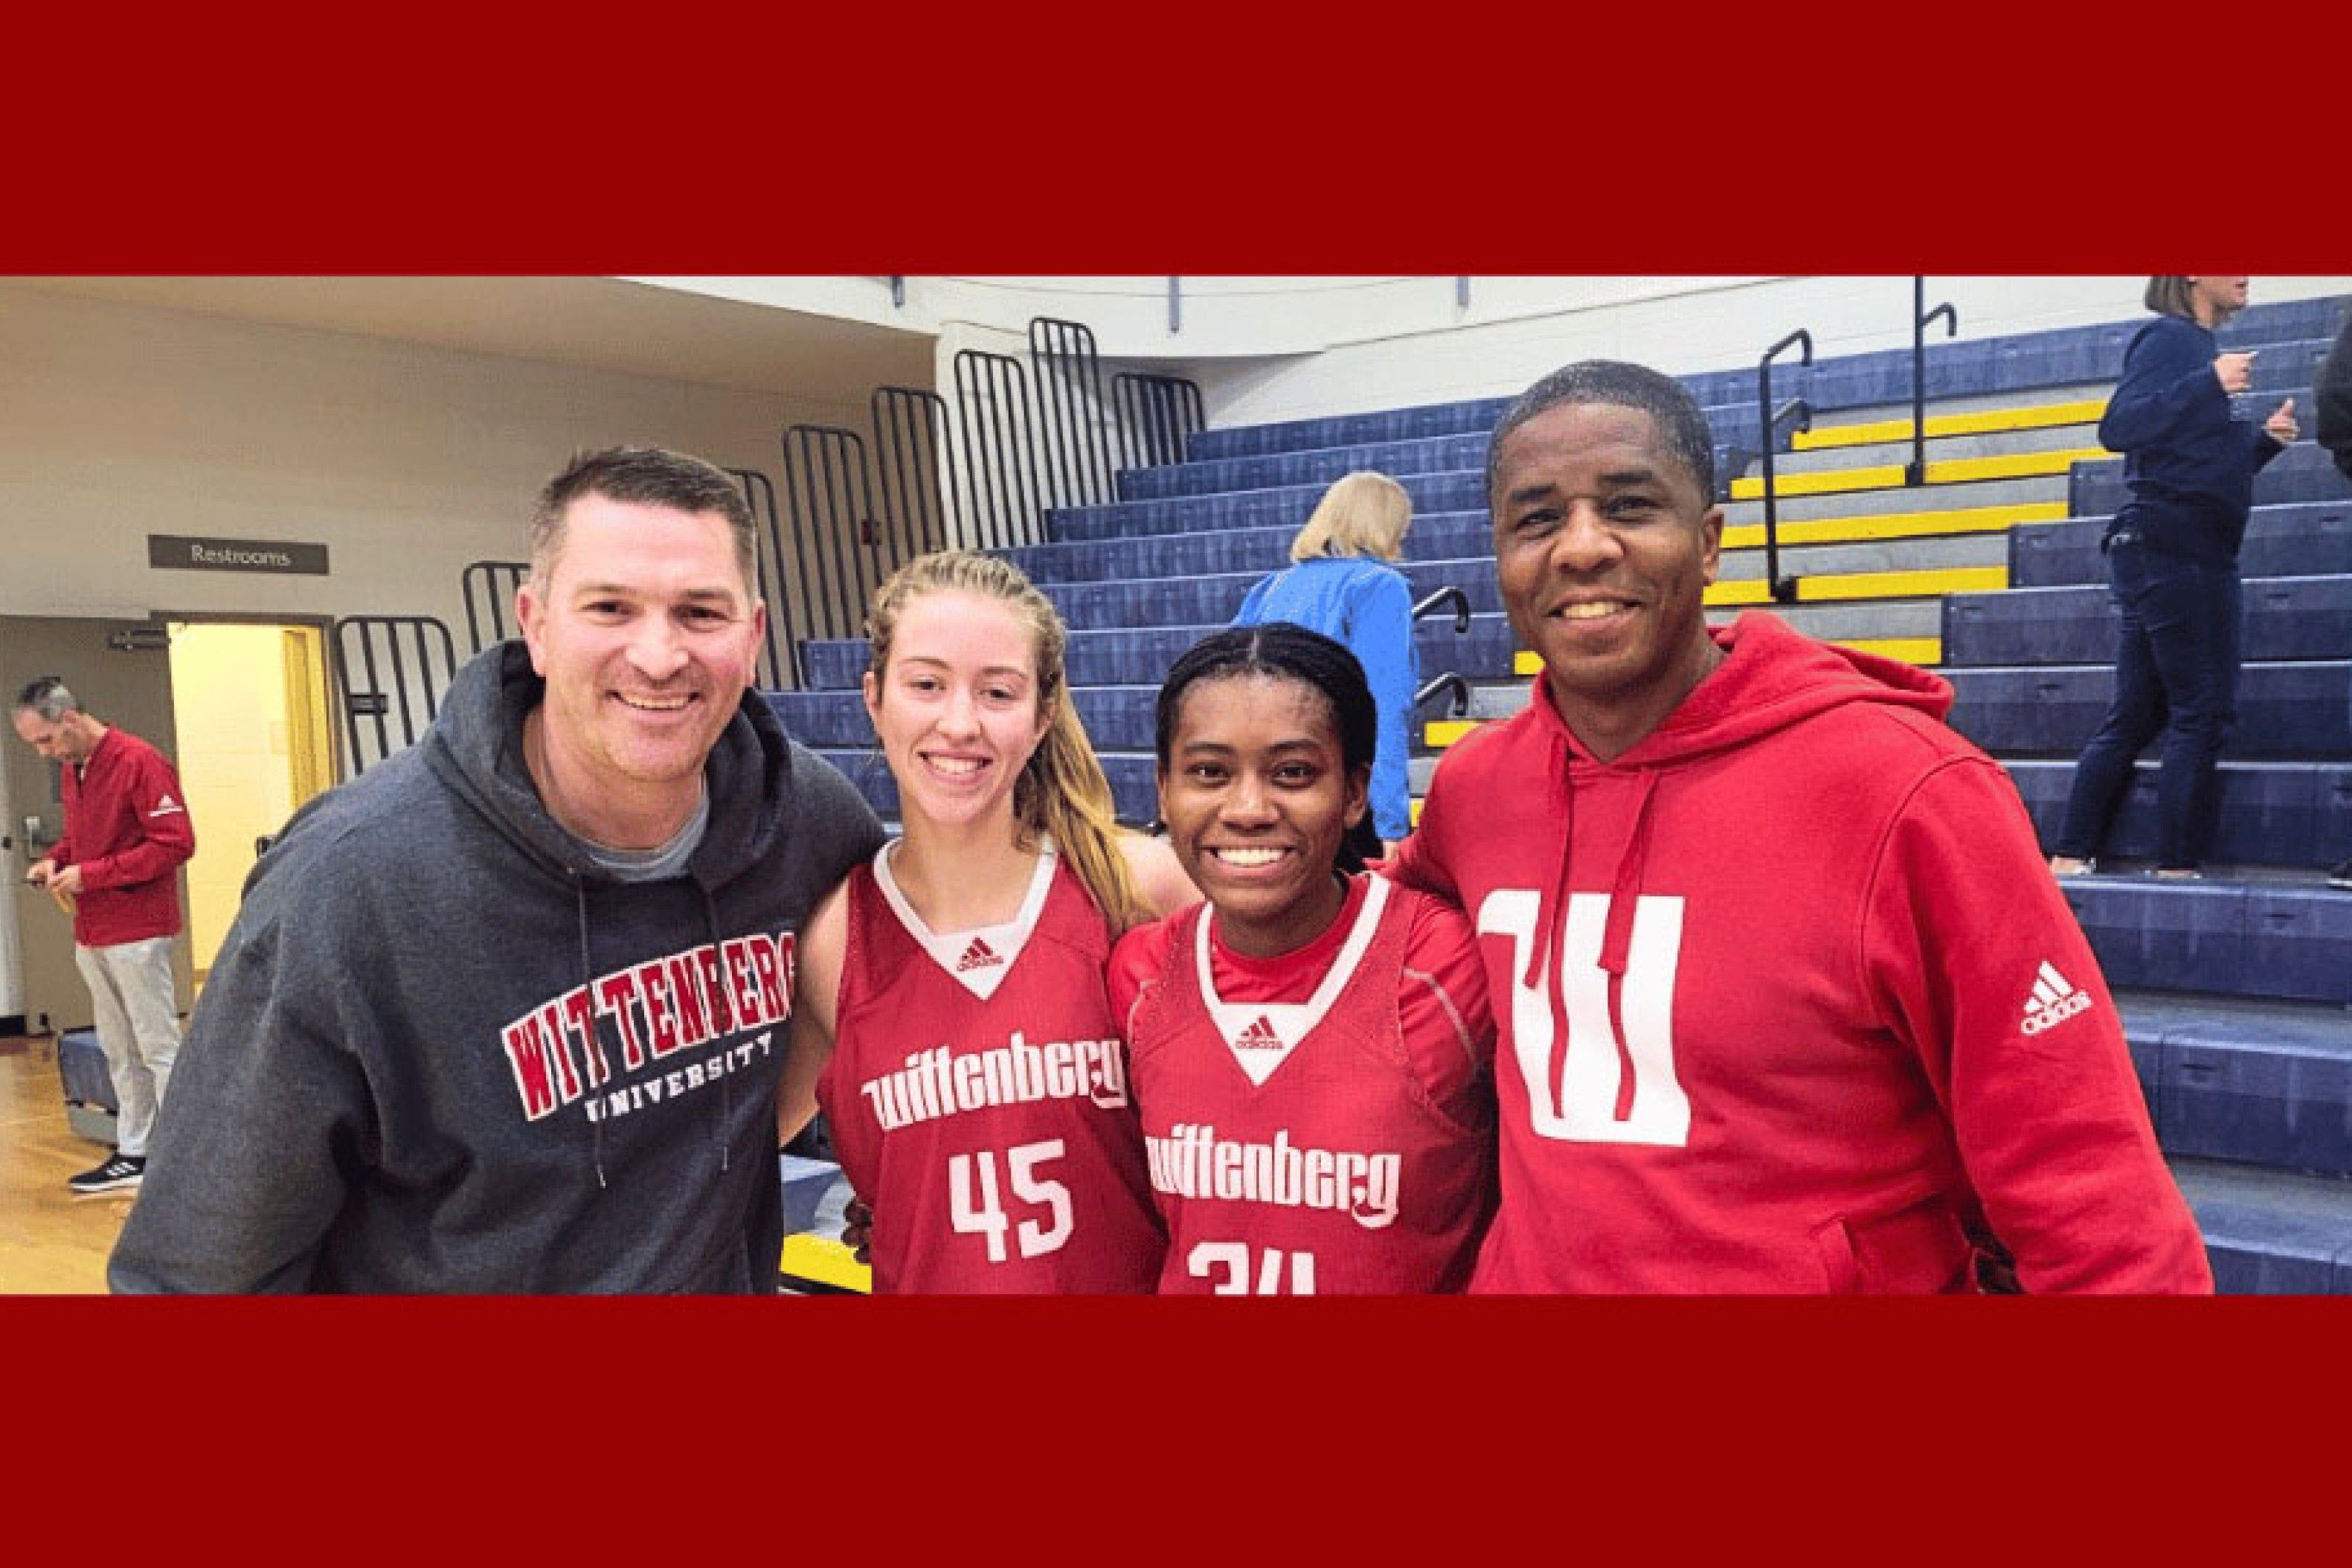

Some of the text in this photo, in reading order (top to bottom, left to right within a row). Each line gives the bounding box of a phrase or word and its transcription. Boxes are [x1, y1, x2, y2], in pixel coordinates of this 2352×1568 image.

[191, 544, 291, 567] Restrooms
[2021, 989, 2092, 1035] adidas
[585, 1032, 772, 1122] UNIVERSITY
[861, 1031, 1128, 1131] wittenberg
[949, 1139, 1074, 1262] 45
